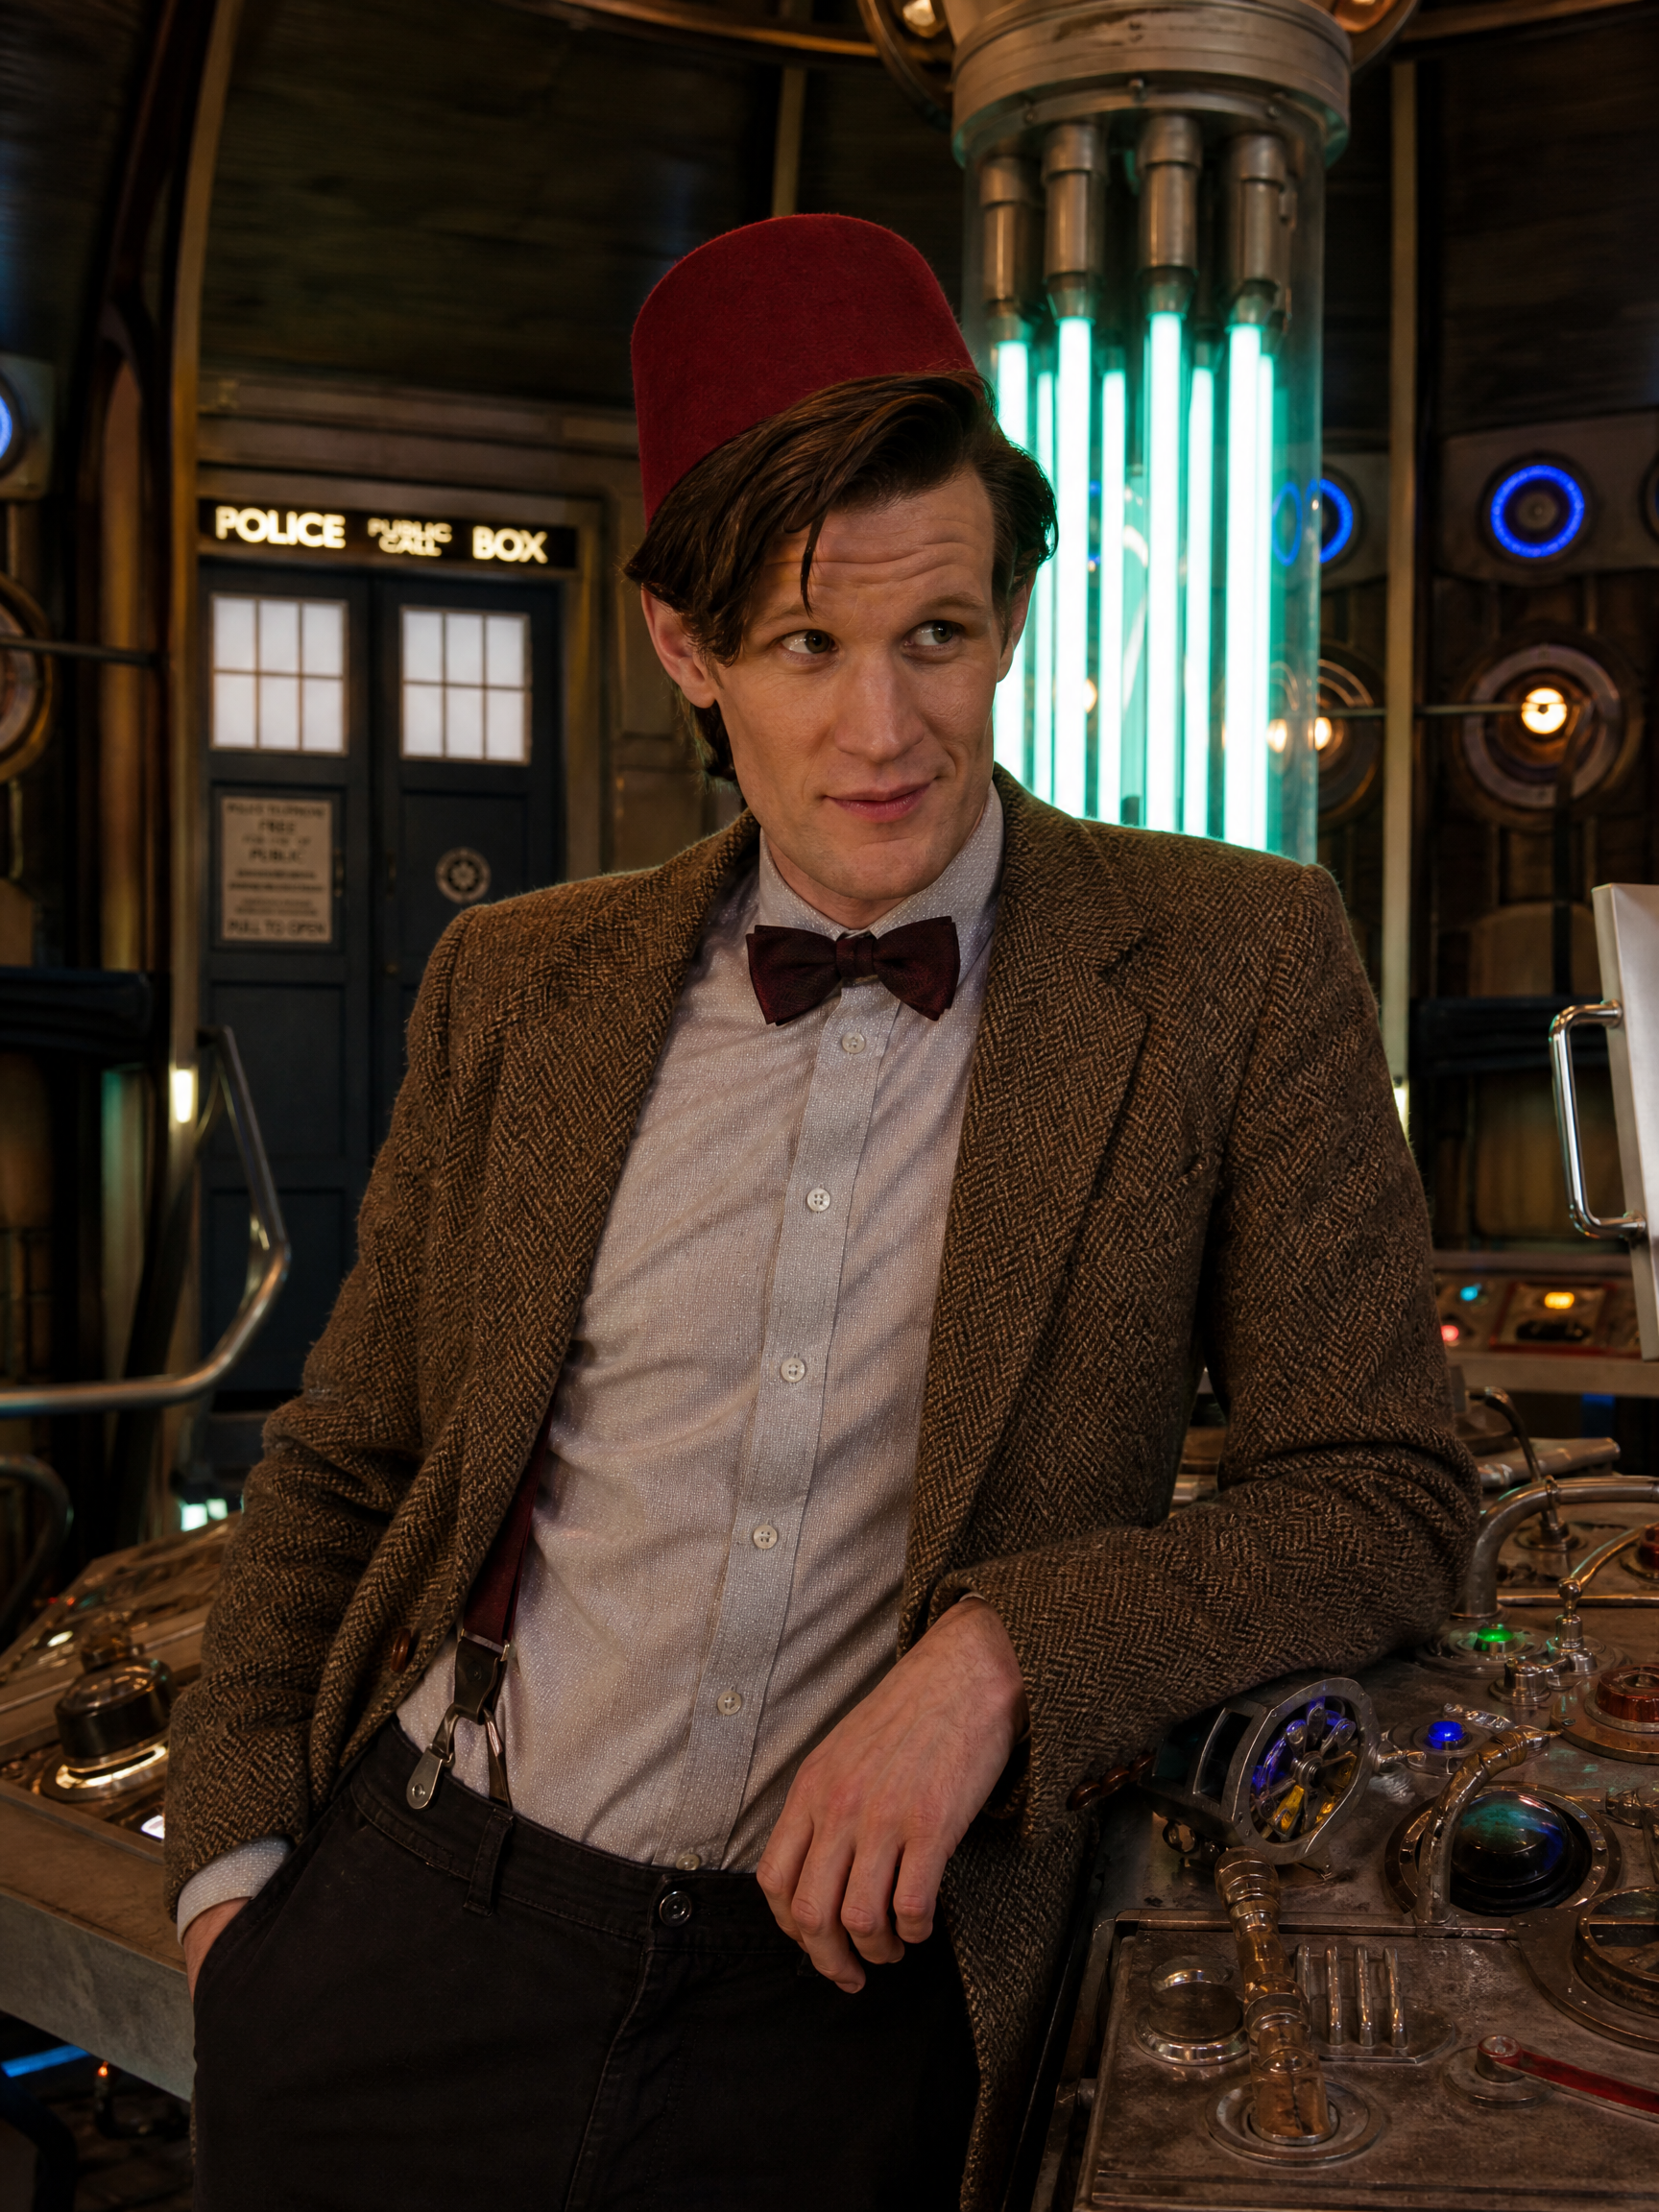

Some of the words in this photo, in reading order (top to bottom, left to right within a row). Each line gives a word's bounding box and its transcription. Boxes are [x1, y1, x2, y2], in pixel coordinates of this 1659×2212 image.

[215, 506, 346, 548] POLICE
[472, 526, 547, 563] BOX
[368, 517, 452, 543] PUBLIC
[378, 534, 443, 557] CALL
